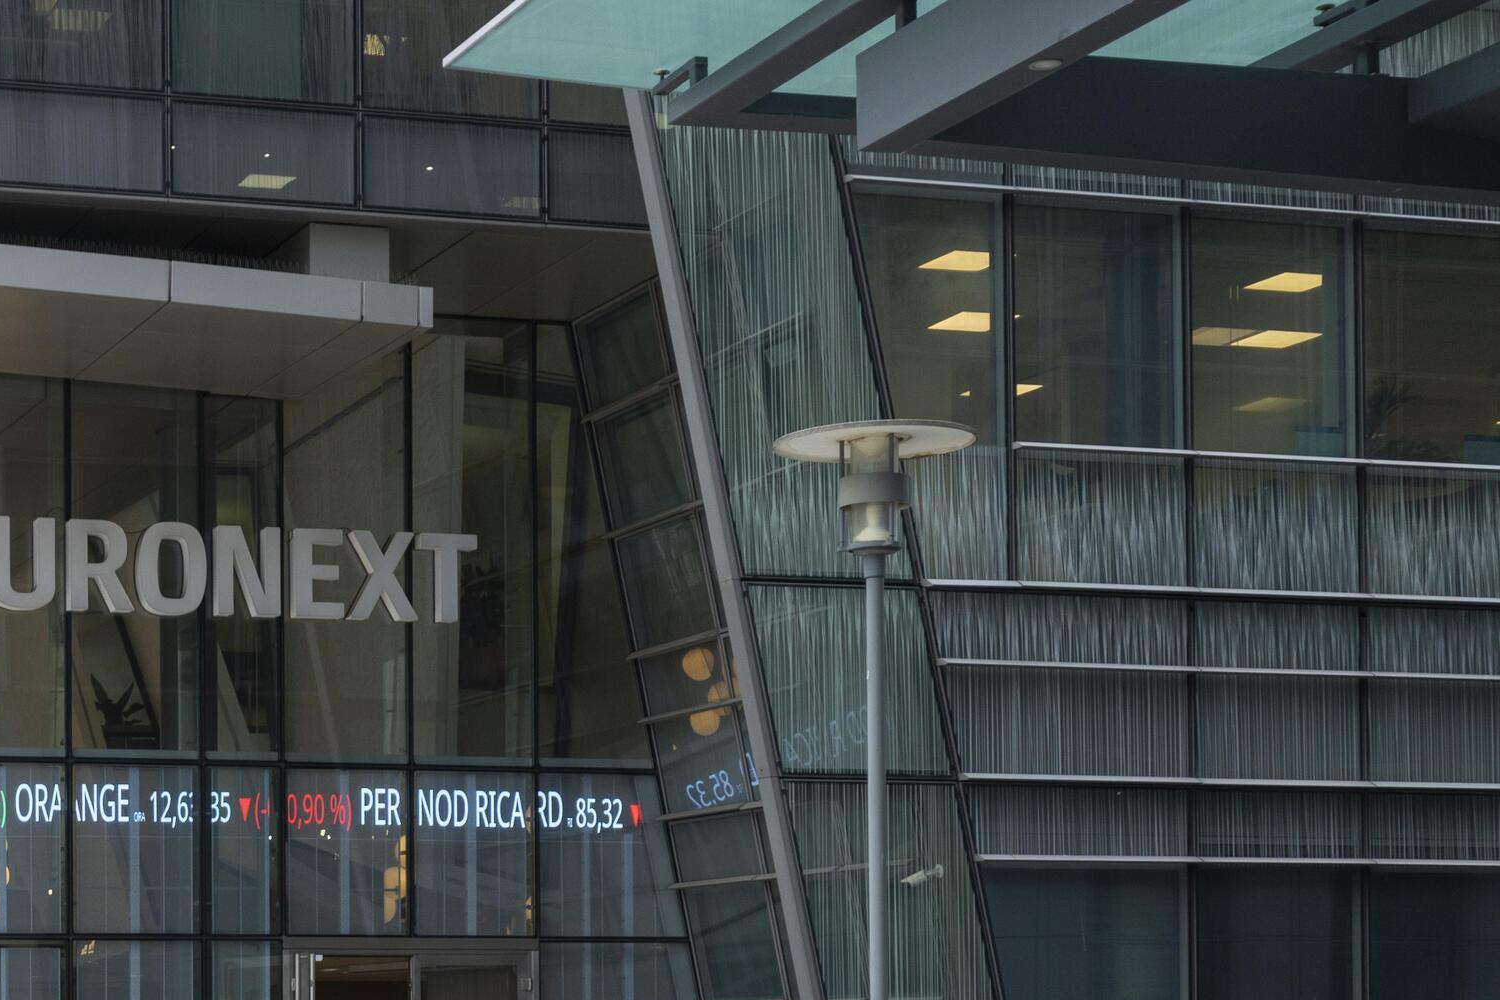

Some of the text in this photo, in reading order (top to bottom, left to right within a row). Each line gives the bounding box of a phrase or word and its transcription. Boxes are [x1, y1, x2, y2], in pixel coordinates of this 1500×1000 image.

[14, 783, 130, 823] ORANGE
[330, 794, 352, 832] %)
[576, 797, 624, 834] 85,32
